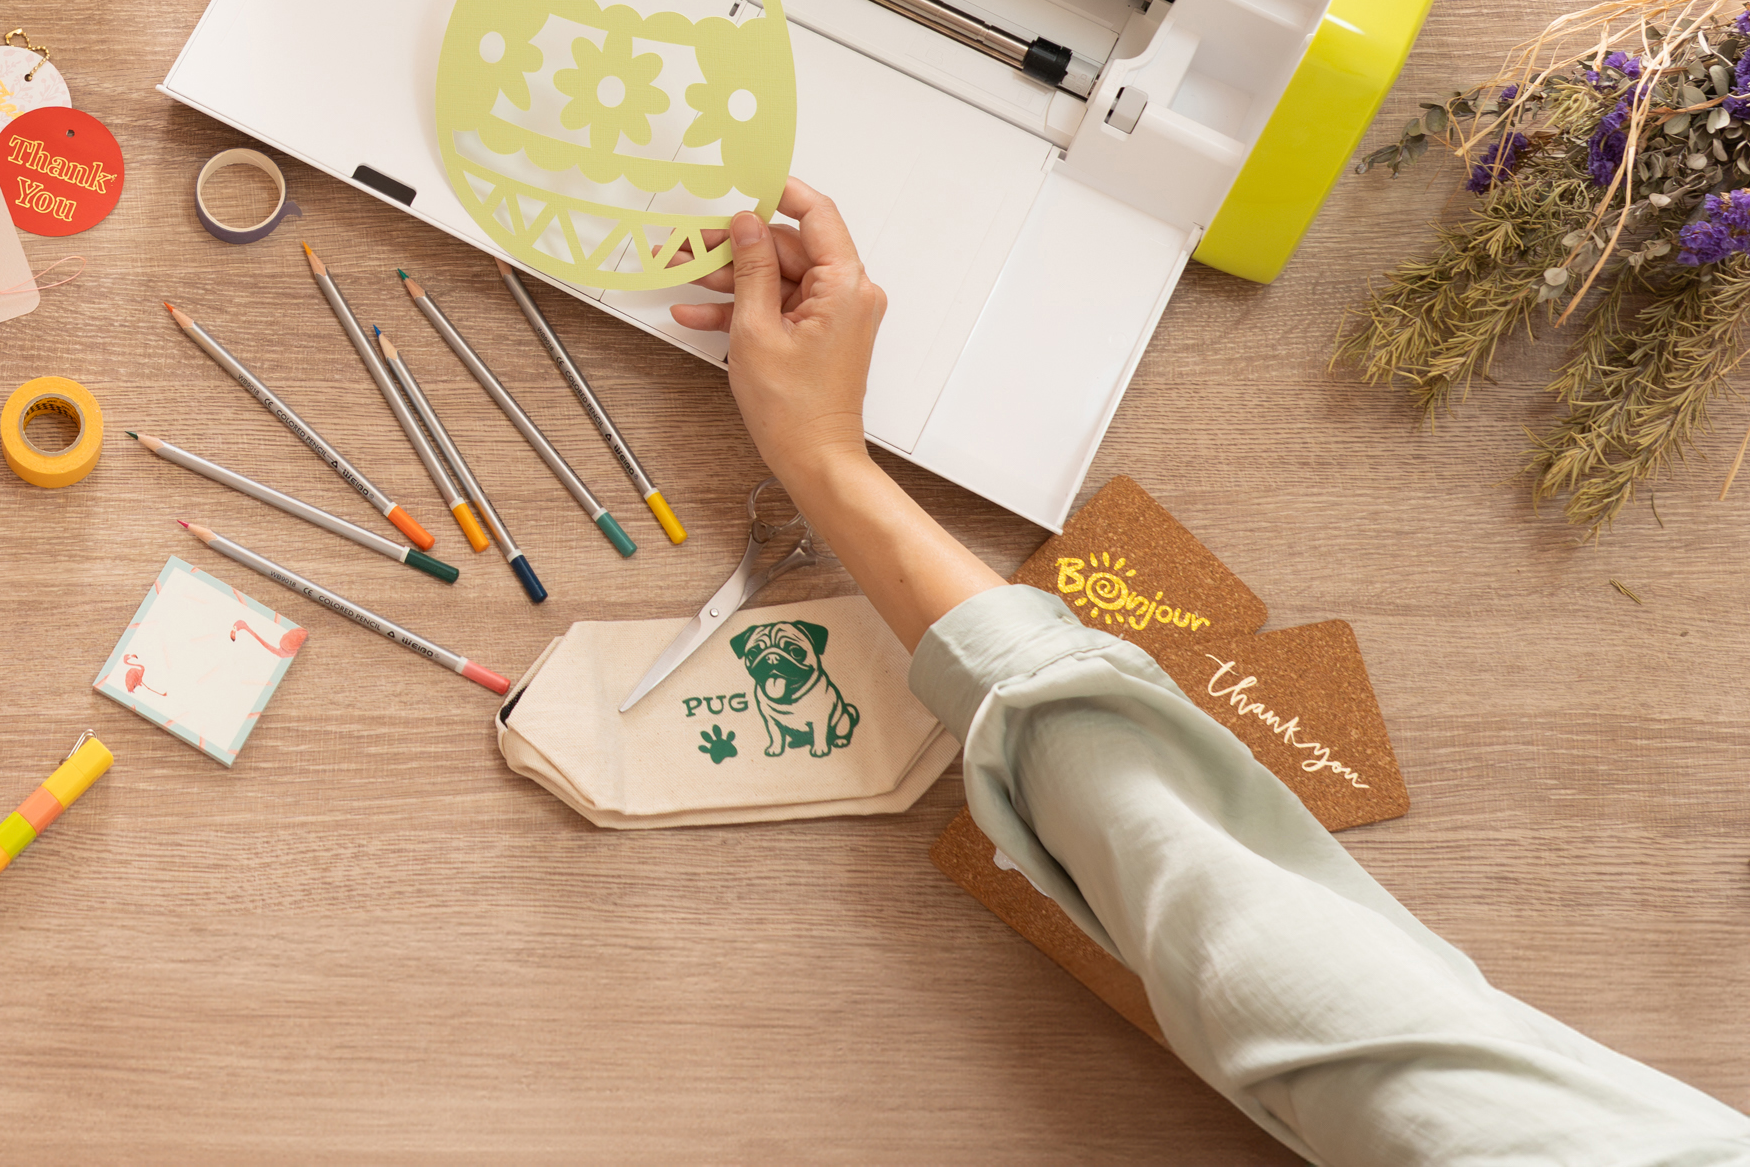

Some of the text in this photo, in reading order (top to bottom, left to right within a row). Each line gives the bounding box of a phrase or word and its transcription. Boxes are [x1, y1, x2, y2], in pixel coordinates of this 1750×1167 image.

[7, 135, 113, 194] Thank
[15, 176, 77, 222] You
[565, 370, 588, 404] COLORED
[586, 403, 604, 428] PENCIL
[276, 409, 306, 438] COLORED
[305, 436, 328, 458] PENCIL
[270, 570, 297, 588] WB9018
[318, 595, 354, 617] COLORED
[355, 613, 381, 631] PENCIL
[1055, 555, 1211, 632] Bonjour
[682, 692, 749, 718] PUG
[1205, 653, 1370, 789] thank you
